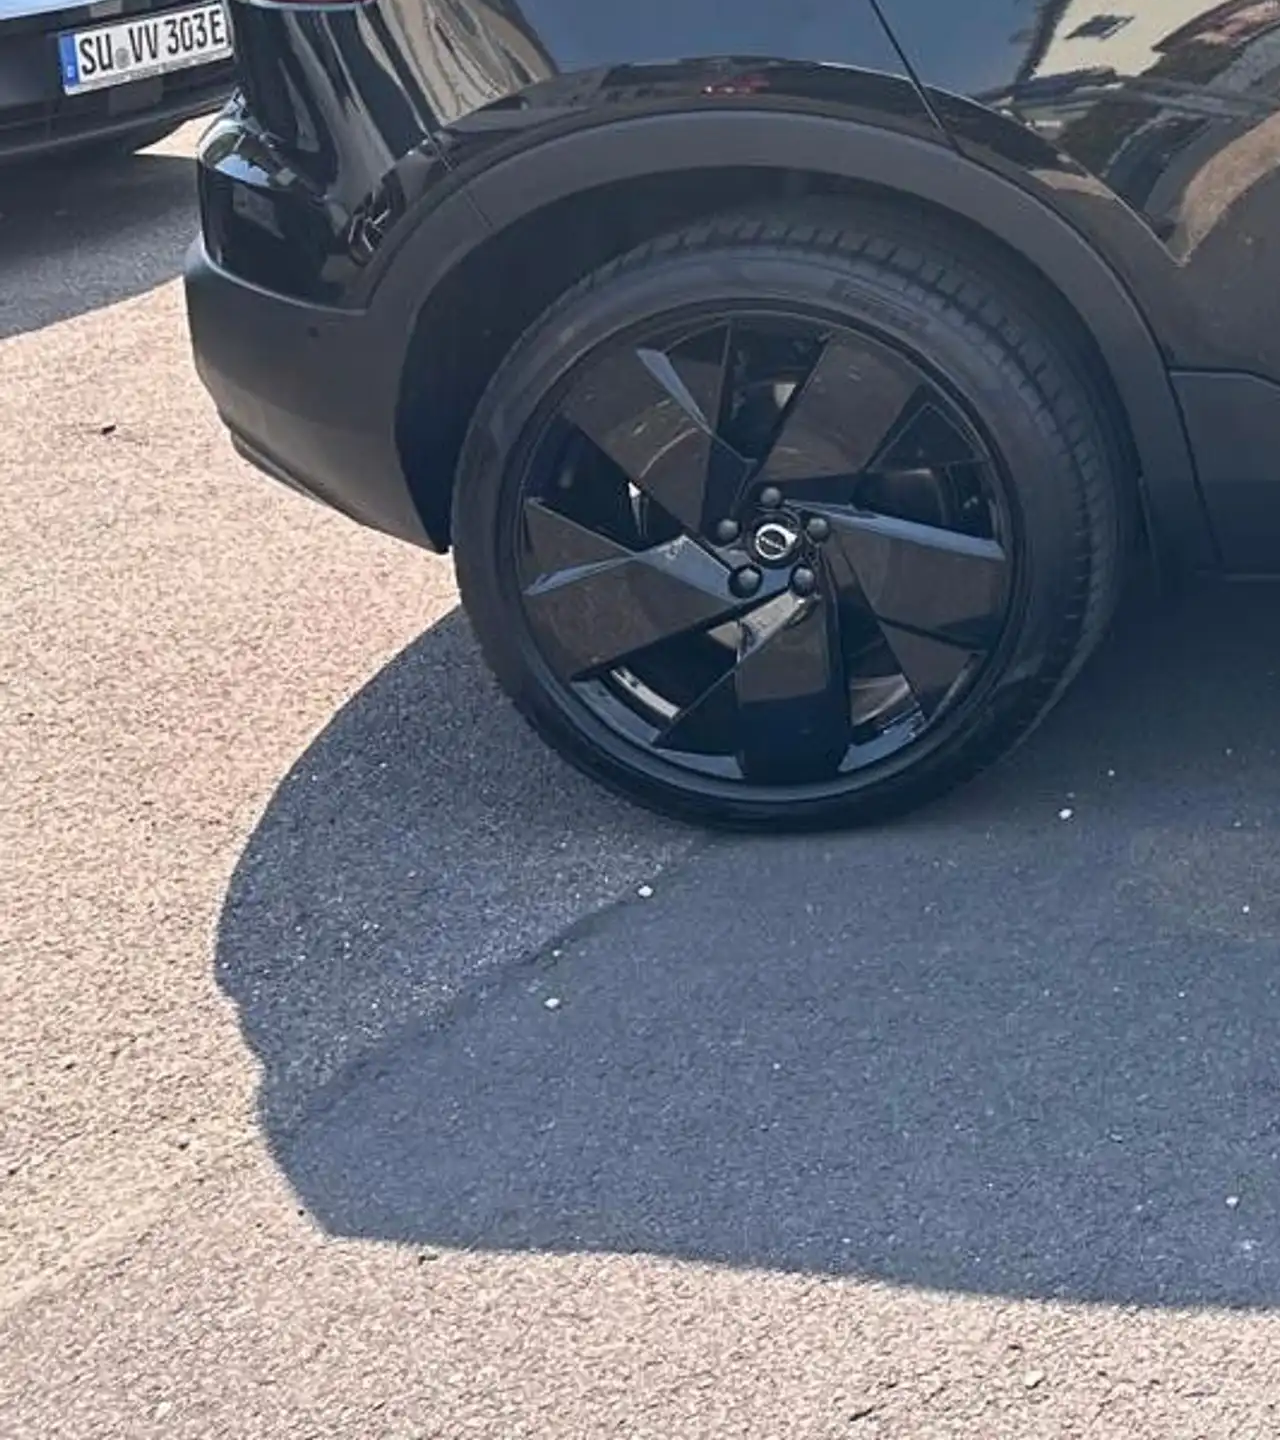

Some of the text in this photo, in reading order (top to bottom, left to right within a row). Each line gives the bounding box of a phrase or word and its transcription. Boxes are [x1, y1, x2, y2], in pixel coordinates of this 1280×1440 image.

[79, 34, 113, 75] SU
[128, 23, 159, 61] VV
[164, 9, 225, 55] 303E
